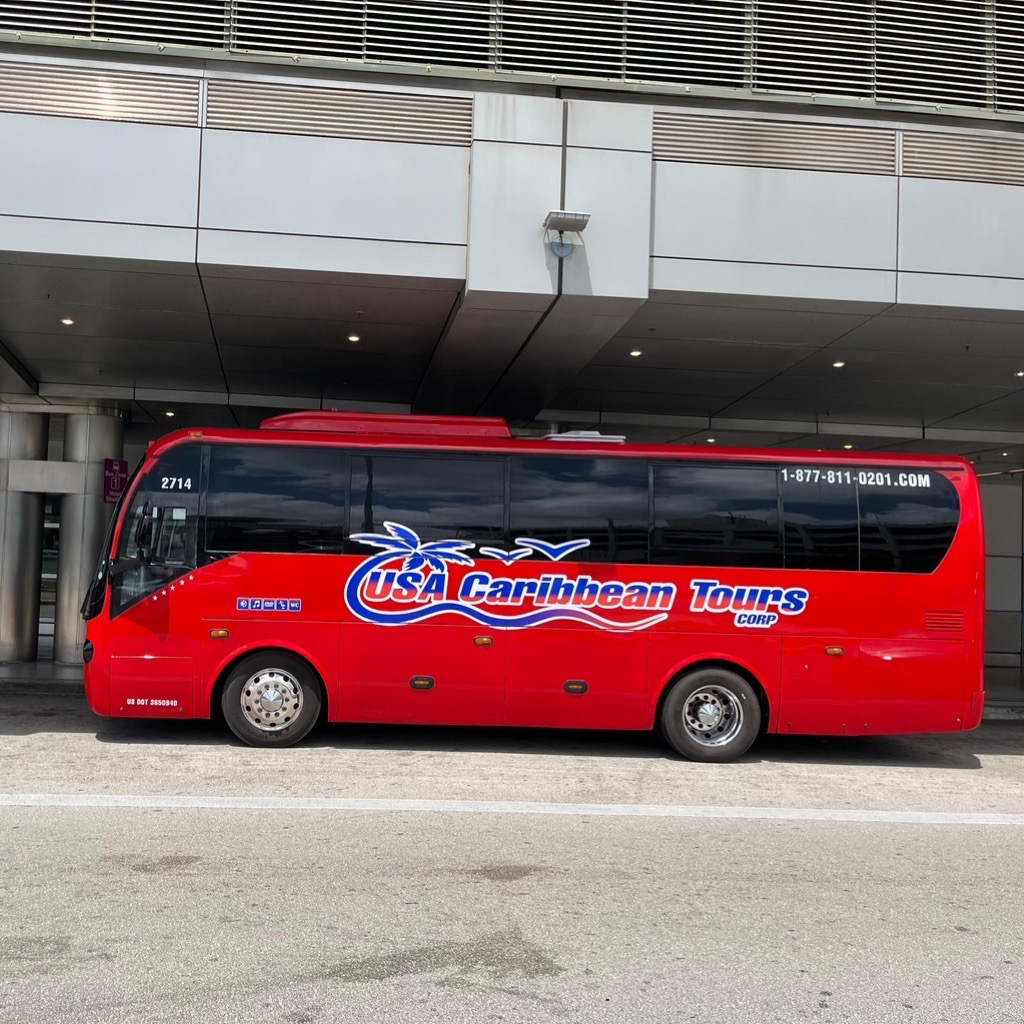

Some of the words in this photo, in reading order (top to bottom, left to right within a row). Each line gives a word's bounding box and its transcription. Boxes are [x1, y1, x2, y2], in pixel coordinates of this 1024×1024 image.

[161, 477, 192, 490] 2714
[781, 468, 931, 488] 1-877-811-0201.COM
[362, 570, 448, 604] USA
[459, 573, 677, 611] Caribbean
[690, 579, 809, 615] Tours
[735, 612, 777, 627] CORP
